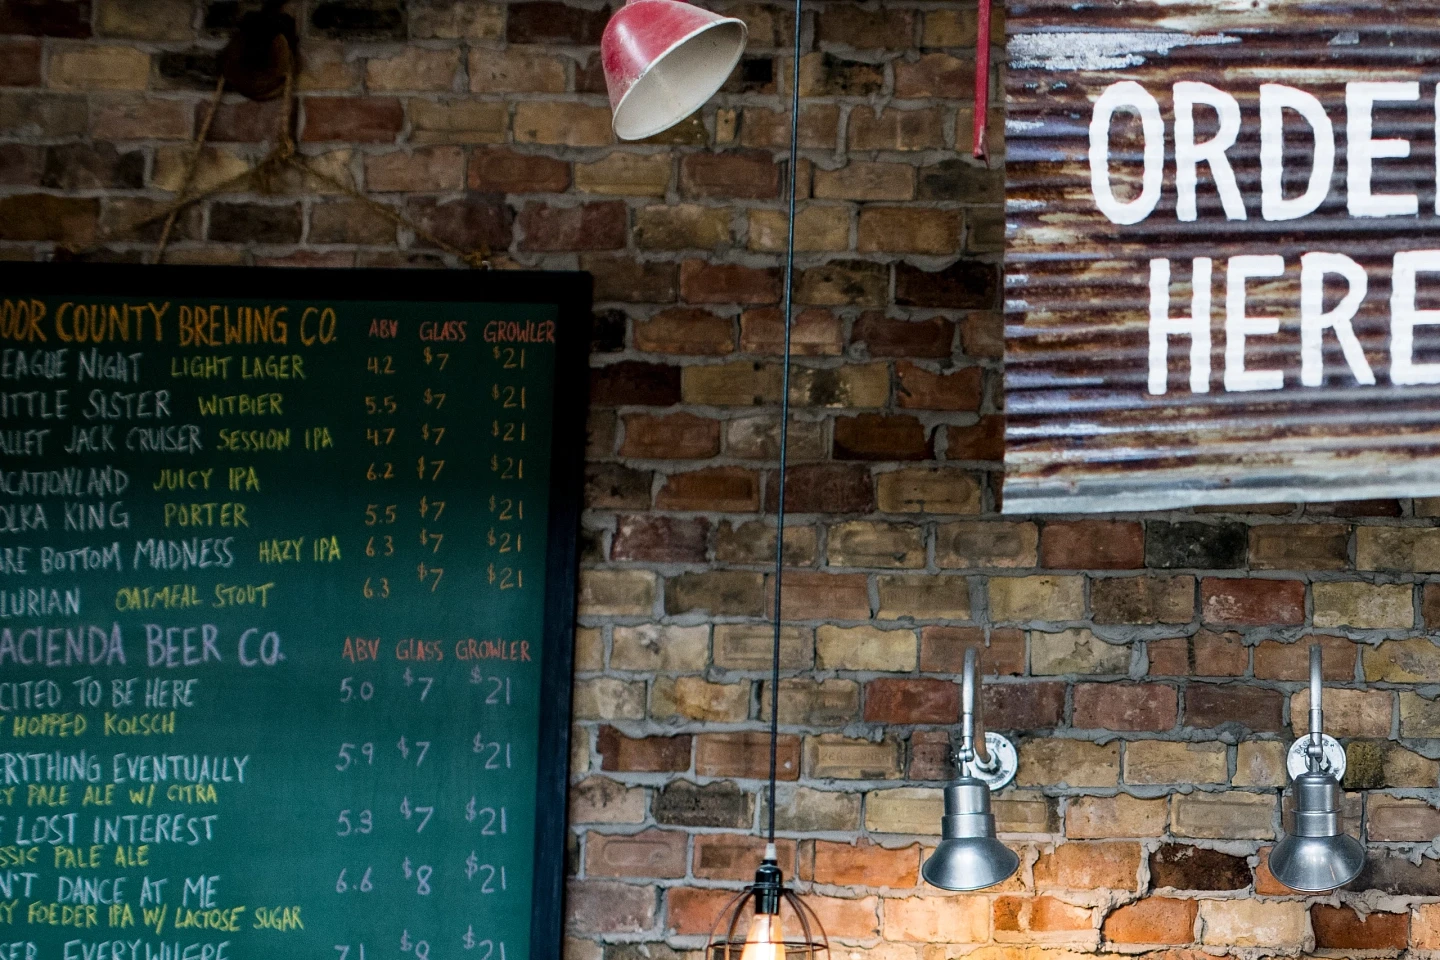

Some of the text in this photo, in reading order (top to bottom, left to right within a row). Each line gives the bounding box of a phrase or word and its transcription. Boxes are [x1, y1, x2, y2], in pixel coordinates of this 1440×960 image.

[56, 301, 170, 342] COUNTY
[179, 304, 288, 347] BREWING
[369, 318, 399, 339] ABV
[419, 320, 468, 341] GLASS
[483, 320, 556, 343] GROWLER
[77, 347, 144, 383] NIGHT
[171, 355, 233, 380] LIGHT
[241, 354, 306, 380] LAGER
[366, 355, 396, 375] 4.2
[82, 388, 172, 419] SISTER
[198, 393, 284, 417] WITBIER
[64, 423, 334, 456] JACK CRUISER SESSION IPA
[153, 467, 214, 491] JUICY
[228, 466, 261, 492] IPA
[366, 462, 395, 481] 6.2
[64, 501, 130, 532] KING
[164, 502, 249, 528] PORTER
[41, 535, 342, 575] BOTTOM MADNESS HAZY IPA
[115, 584, 201, 612] OATMEAL
[212, 582, 275, 609] STOUT
[363, 577, 390, 599] 6.3
[143, 623, 222, 668] BEER
[341, 637, 381, 664] ABV
[395, 638, 444, 662] GLASS
[455, 637, 532, 663] GROWLER
[72, 675, 101, 707] TO
[111, 677, 140, 708] BE
[144, 676, 199, 709] HERE
[12, 710, 176, 738] HOPPED KOLSCH
[113, 752, 249, 784] EVENTUALLY
[27, 784, 70, 807] PALE
[82, 783, 116, 806] ALE
[166, 783, 218, 806] CITRA
[15, 812, 219, 846] LOST INTEREST
[53, 844, 104, 869] PALE
[114, 844, 150, 868] ALE
[57, 875, 128, 905] DANCE
[140, 874, 169, 908] AT
[182, 873, 221, 909] ME
[335, 866, 373, 894] 6.6
[27, 899, 98, 929] FOEDER
[108, 903, 135, 929] IPA
[175, 905, 246, 932] LACTOSE
[253, 905, 304, 932] SUGAR
